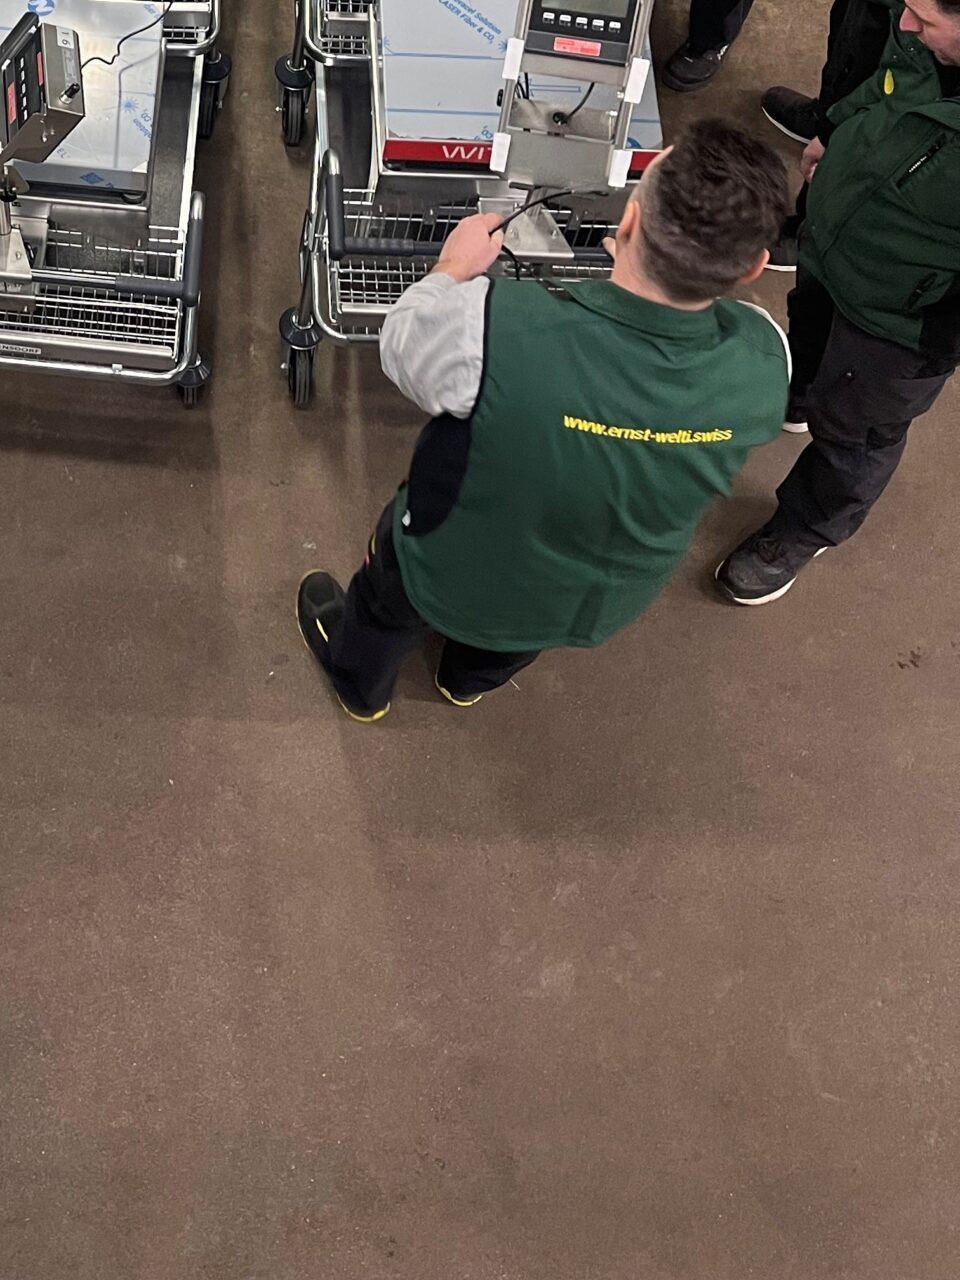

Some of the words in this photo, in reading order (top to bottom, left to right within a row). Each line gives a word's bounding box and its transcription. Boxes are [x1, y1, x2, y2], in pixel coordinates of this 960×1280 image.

[460, 13, 478, 28] Fiber
[474, 12, 502, 34] Solution
[563, 415, 733, 444] www.ernst-welti.swiss
